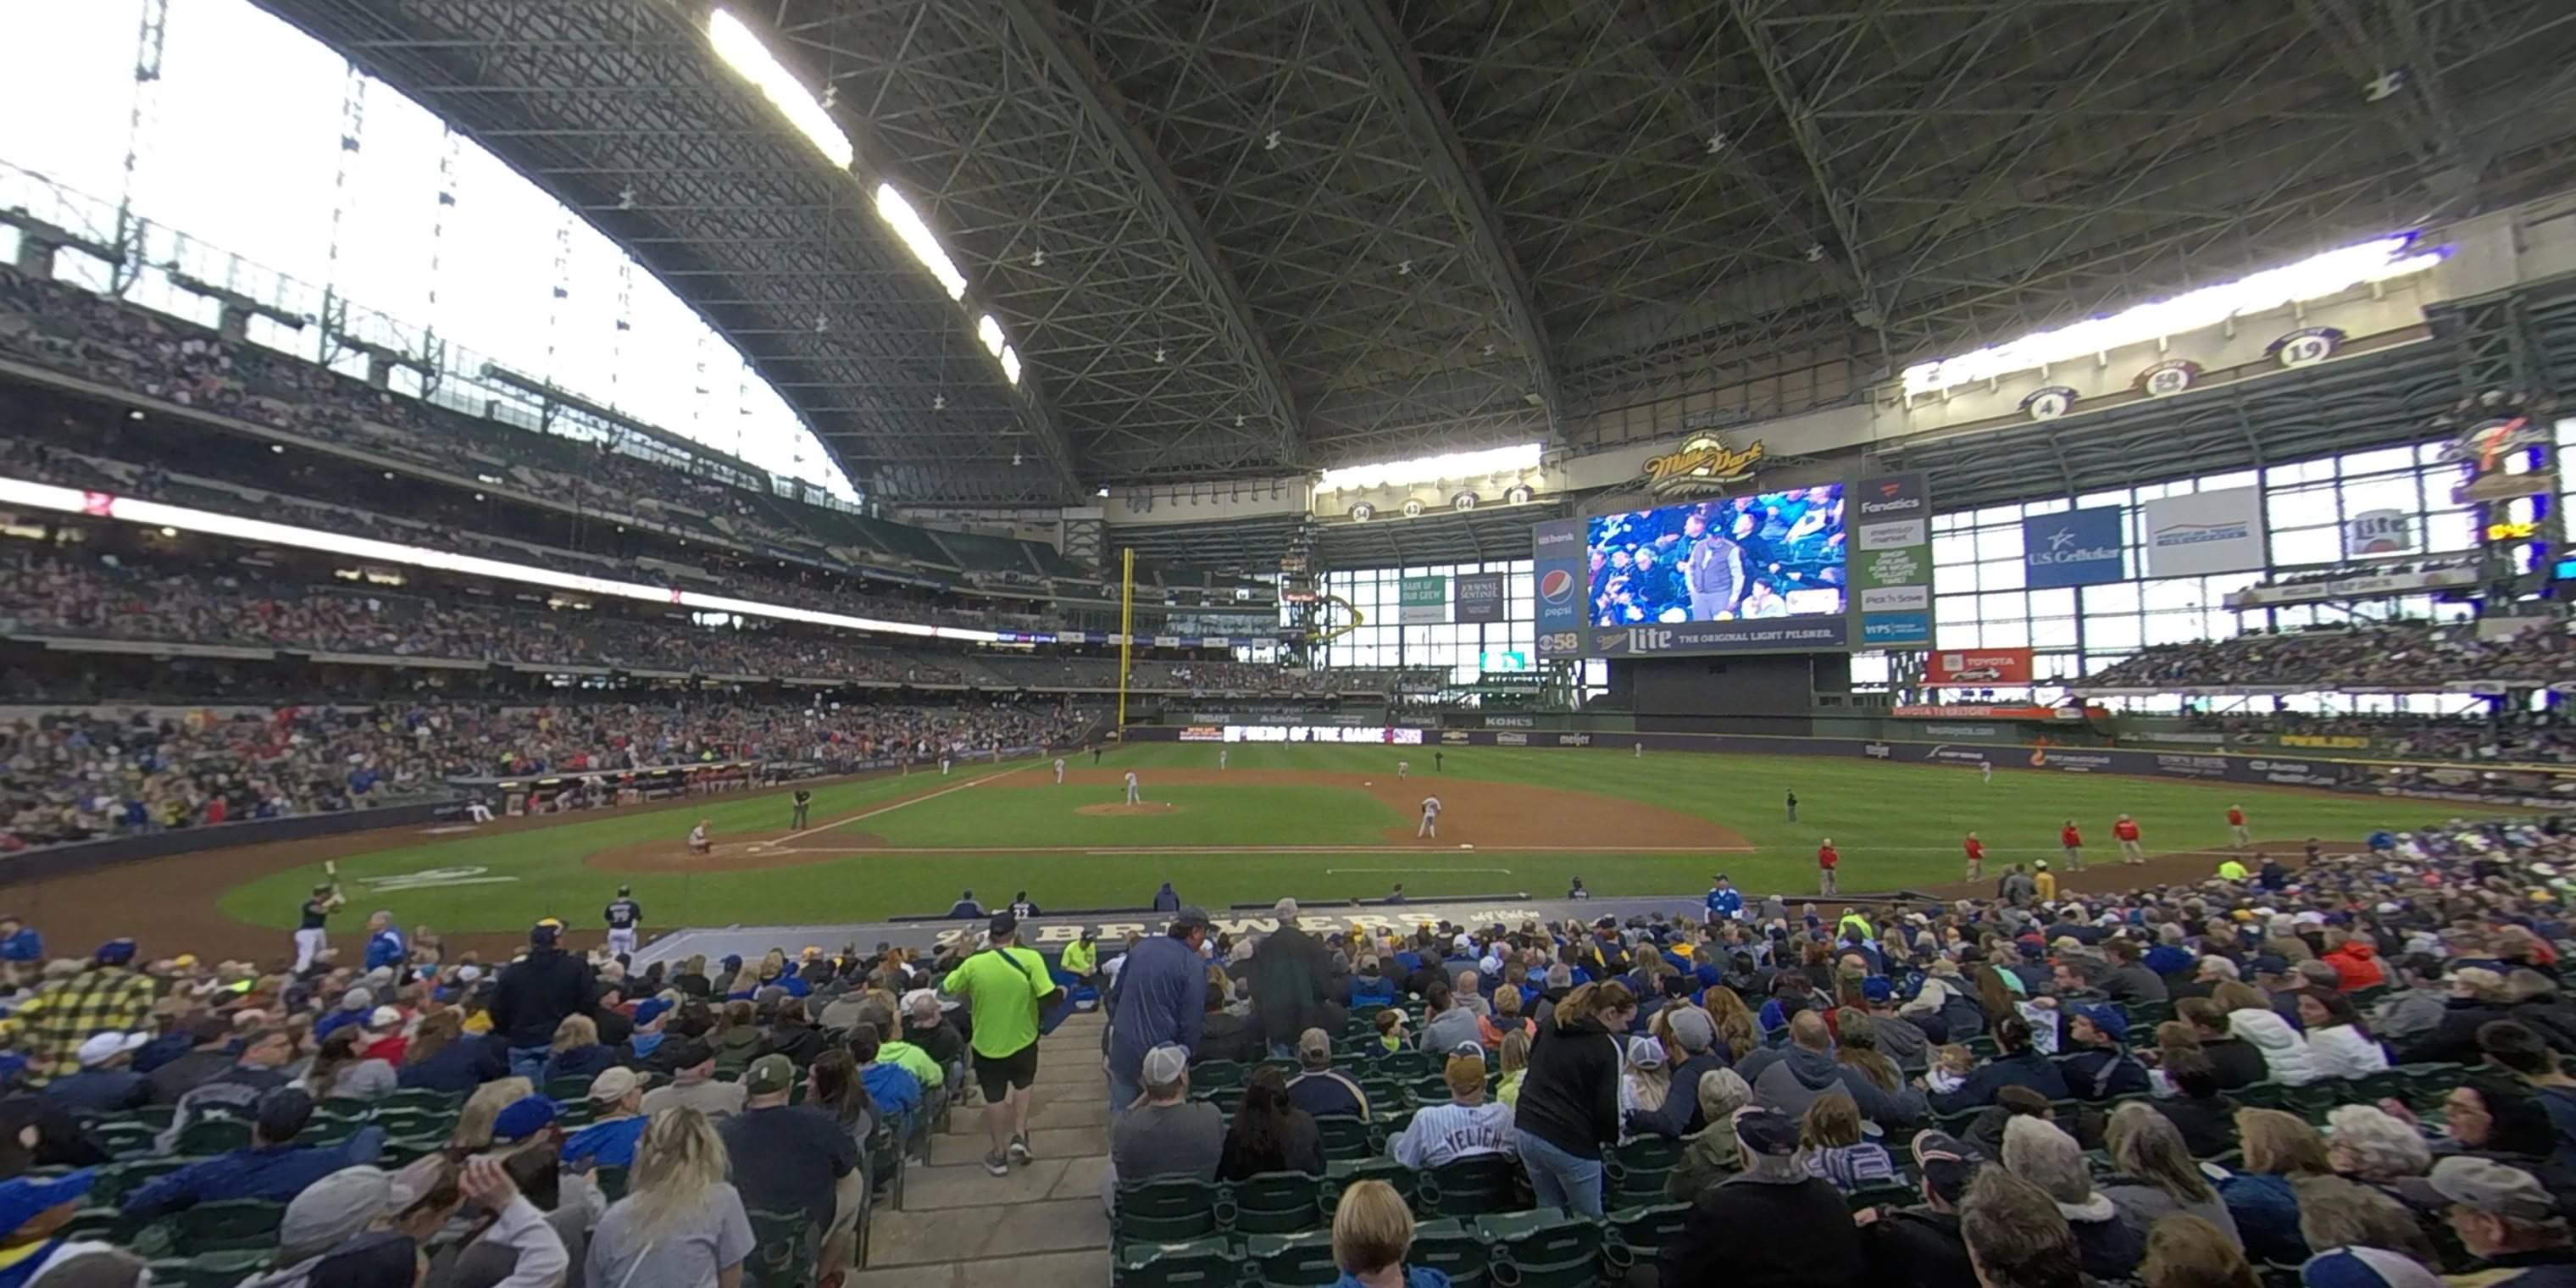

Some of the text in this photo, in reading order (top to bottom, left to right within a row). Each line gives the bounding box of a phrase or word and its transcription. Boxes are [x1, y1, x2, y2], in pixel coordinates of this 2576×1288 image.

[2289, 342, 2322, 361] 19
[2040, 399, 2053, 414] 4
[1707, 439, 1763, 475] Park
[1406, 504, 1418, 514] 42
[1457, 499, 1472, 509] 44
[1861, 498, 1919, 514] Fanatics
[1355, 508, 1368, 519] 34
[2055, 547, 2120, 564] Cellular
[1461, 582, 1498, 592] JOURNAL
[1419, 591, 1442, 600] CREW
[1460, 590, 1499, 599] SENTINEL
[1545, 605, 1572, 618] pepsi
[1864, 624, 1890, 634] WPS
[1552, 632, 1578, 652] 58
[1627, 628, 1672, 654] Lite
[1679, 636, 1698, 644] THE
[1701, 632, 1748, 643] ORIGINAL
[1751, 630, 1783, 641] LIGHT
[1966, 657, 2015, 667] TOYOTA
[1891, 706, 1991, 717] TOYOTA TERRITORY
[1485, 717, 1534, 726] KOHL'S
[1246, 725, 1287, 741] HERO
[1289, 726, 1310, 741] OF
[1312, 726, 1341, 741] THE
[1342, 727, 1385, 742] GAME
[1559, 731, 1591, 747] meijer
[1035, 913, 1443, 942] BRWERS
[1444, 1125, 1502, 1154] YELICH
